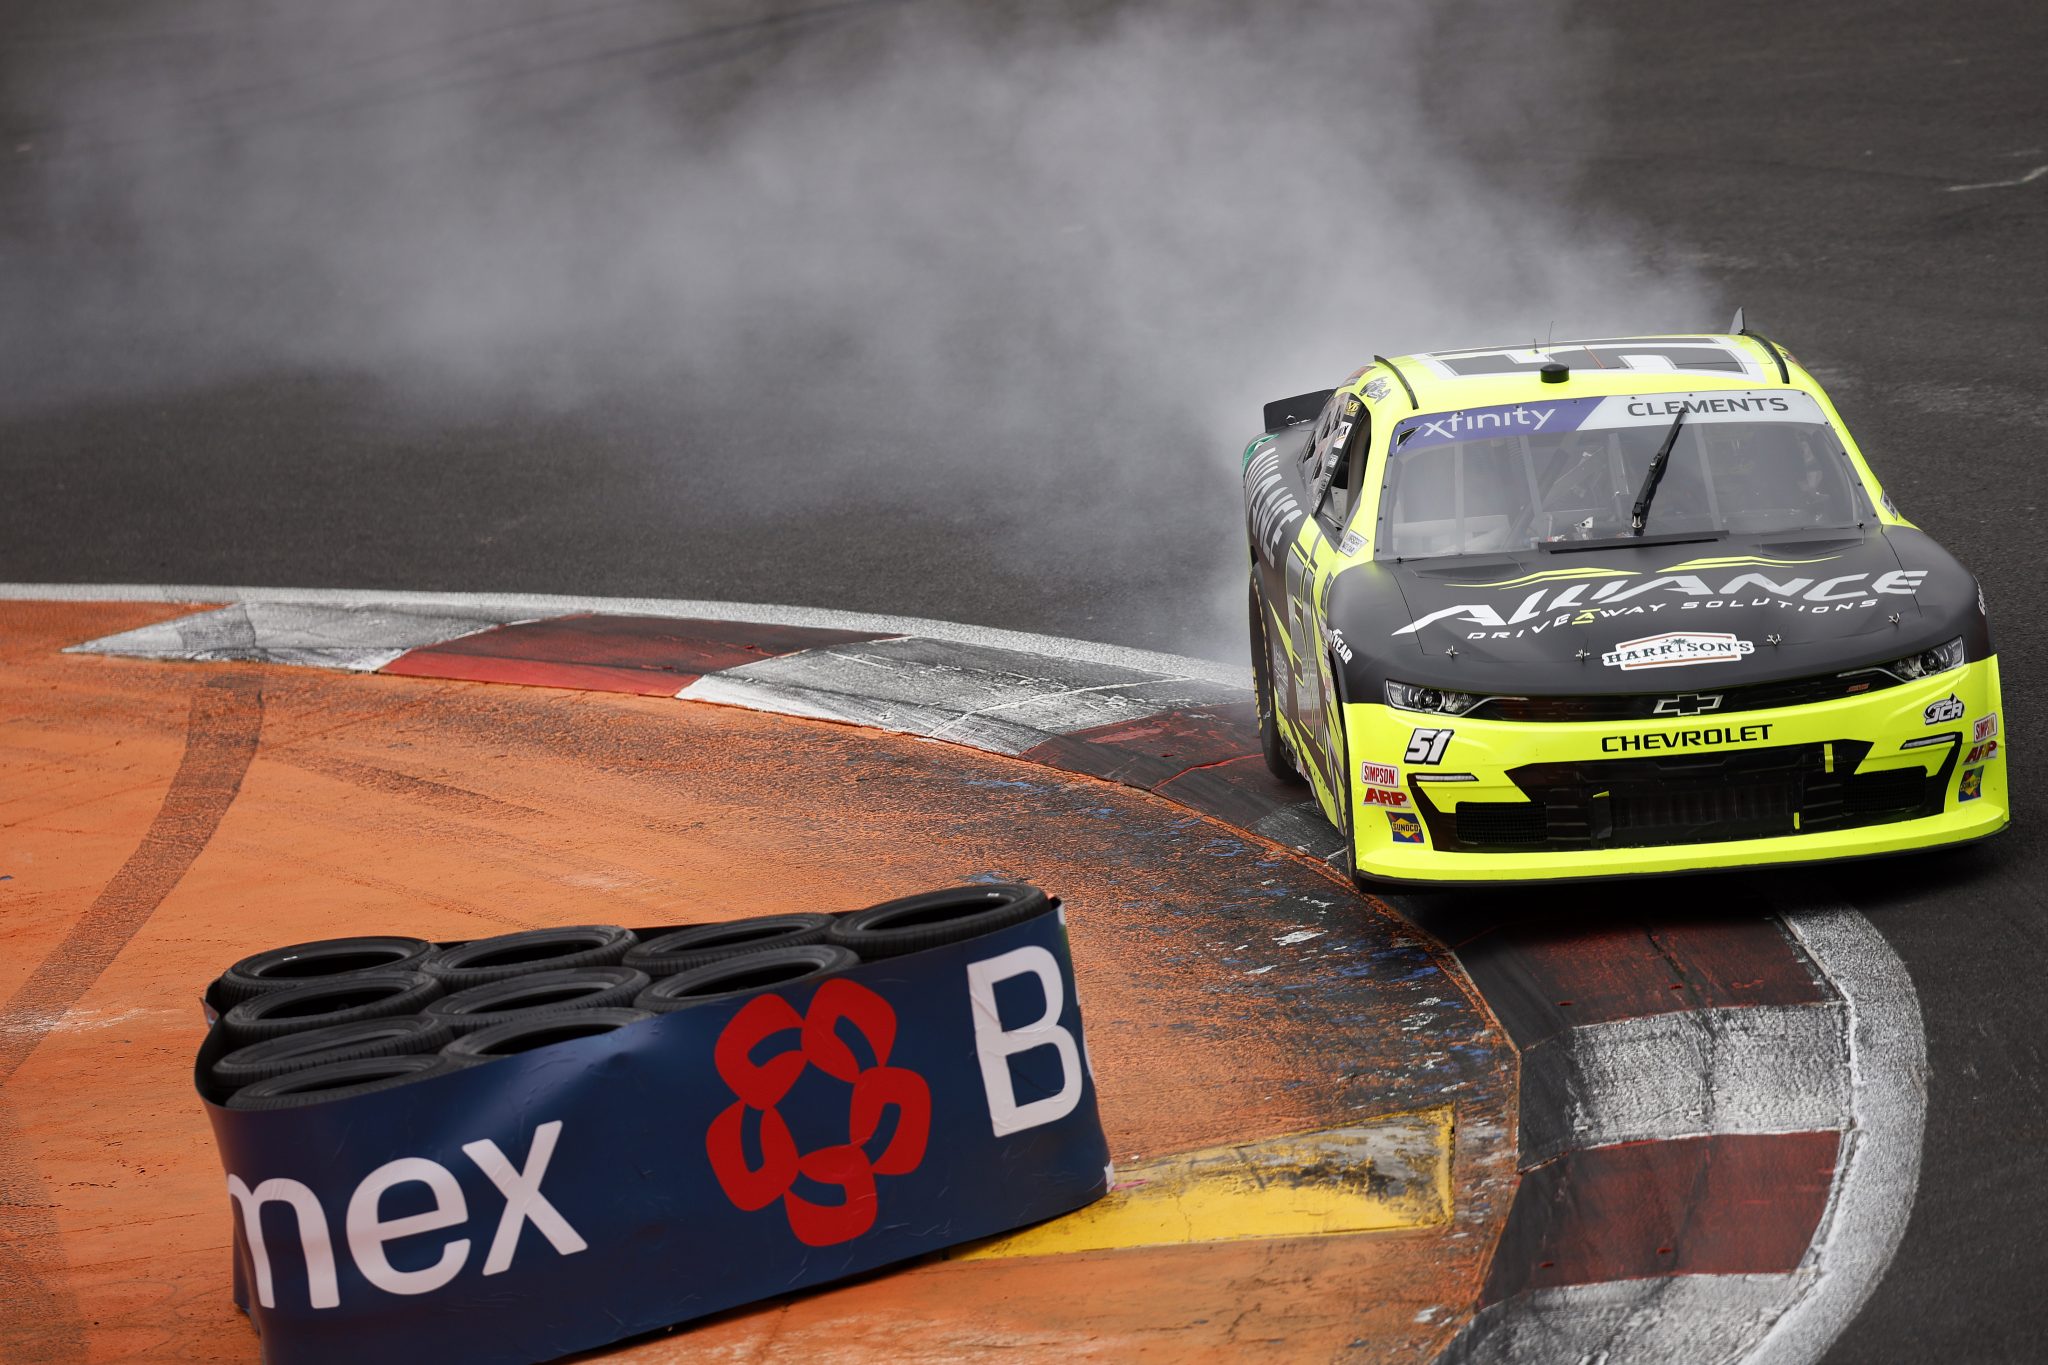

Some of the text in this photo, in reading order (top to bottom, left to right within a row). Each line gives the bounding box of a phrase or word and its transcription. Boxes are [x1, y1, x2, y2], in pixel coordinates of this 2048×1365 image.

[1627, 397, 1789, 417] CLEMENTS
[1423, 408, 1555, 439] xfinity
[1391, 570, 1928, 636] ALLIANCE
[1467, 598, 1879, 640] DRIVEAWAY SOLUTIONS
[1606, 640, 1751, 664] HARRISON'S
[1404, 728, 1455, 766] 51
[1601, 723, 1773, 753] CHEVROLET
[1364, 765, 1395, 785] SIMPSON
[1364, 787, 1408, 806] ARP
[1393, 821, 1419, 833] SUNOCO
[967, 945, 1088, 1137] B
